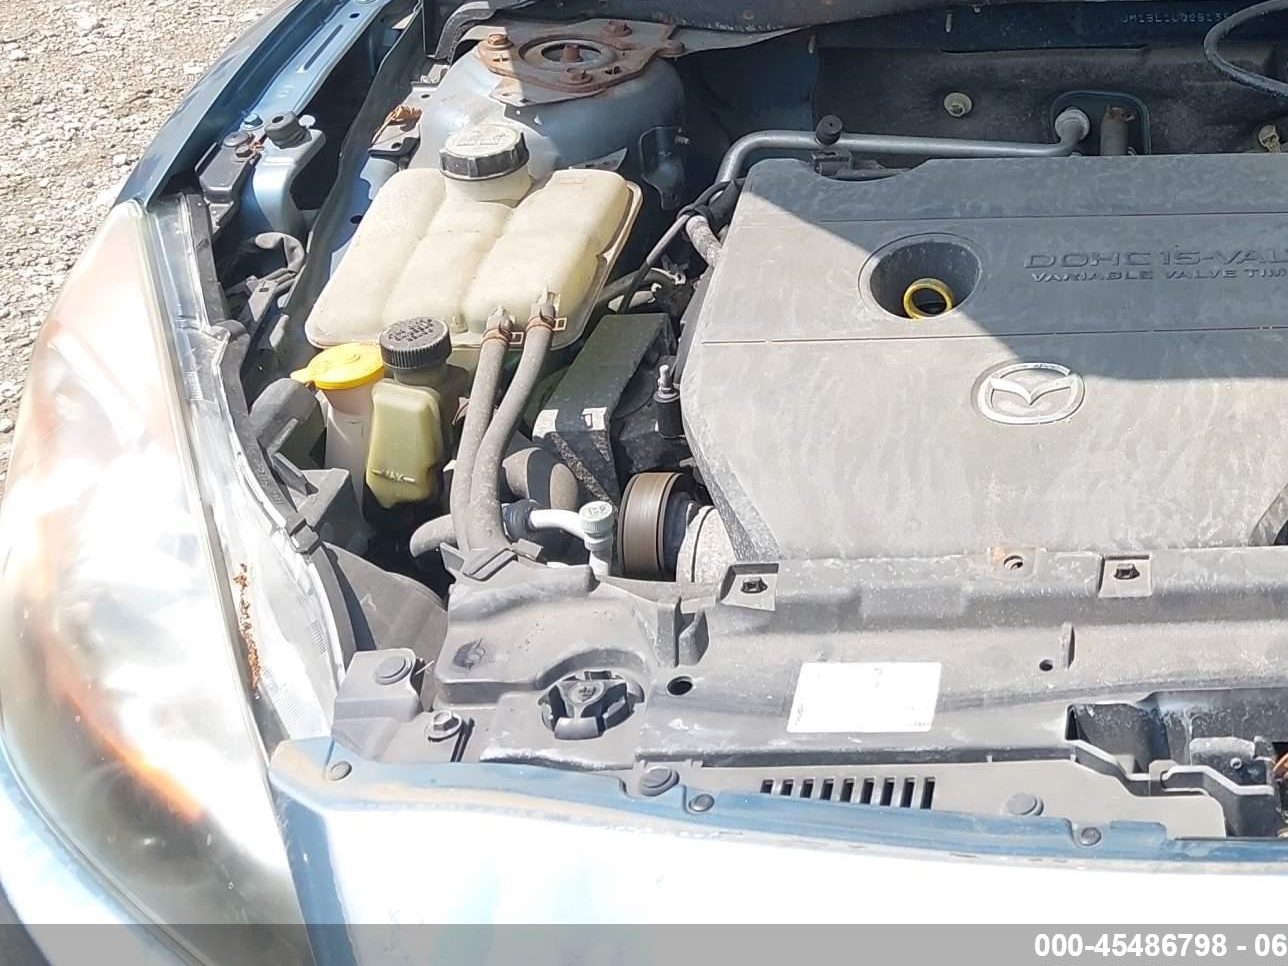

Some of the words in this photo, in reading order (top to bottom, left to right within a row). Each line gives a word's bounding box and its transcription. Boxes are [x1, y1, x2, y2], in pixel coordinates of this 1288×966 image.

[1024, 251, 1152, 269] DOHC
[1031, 269, 1154, 283] VARIABLE
[1164, 267, 1238, 280] VALVE
